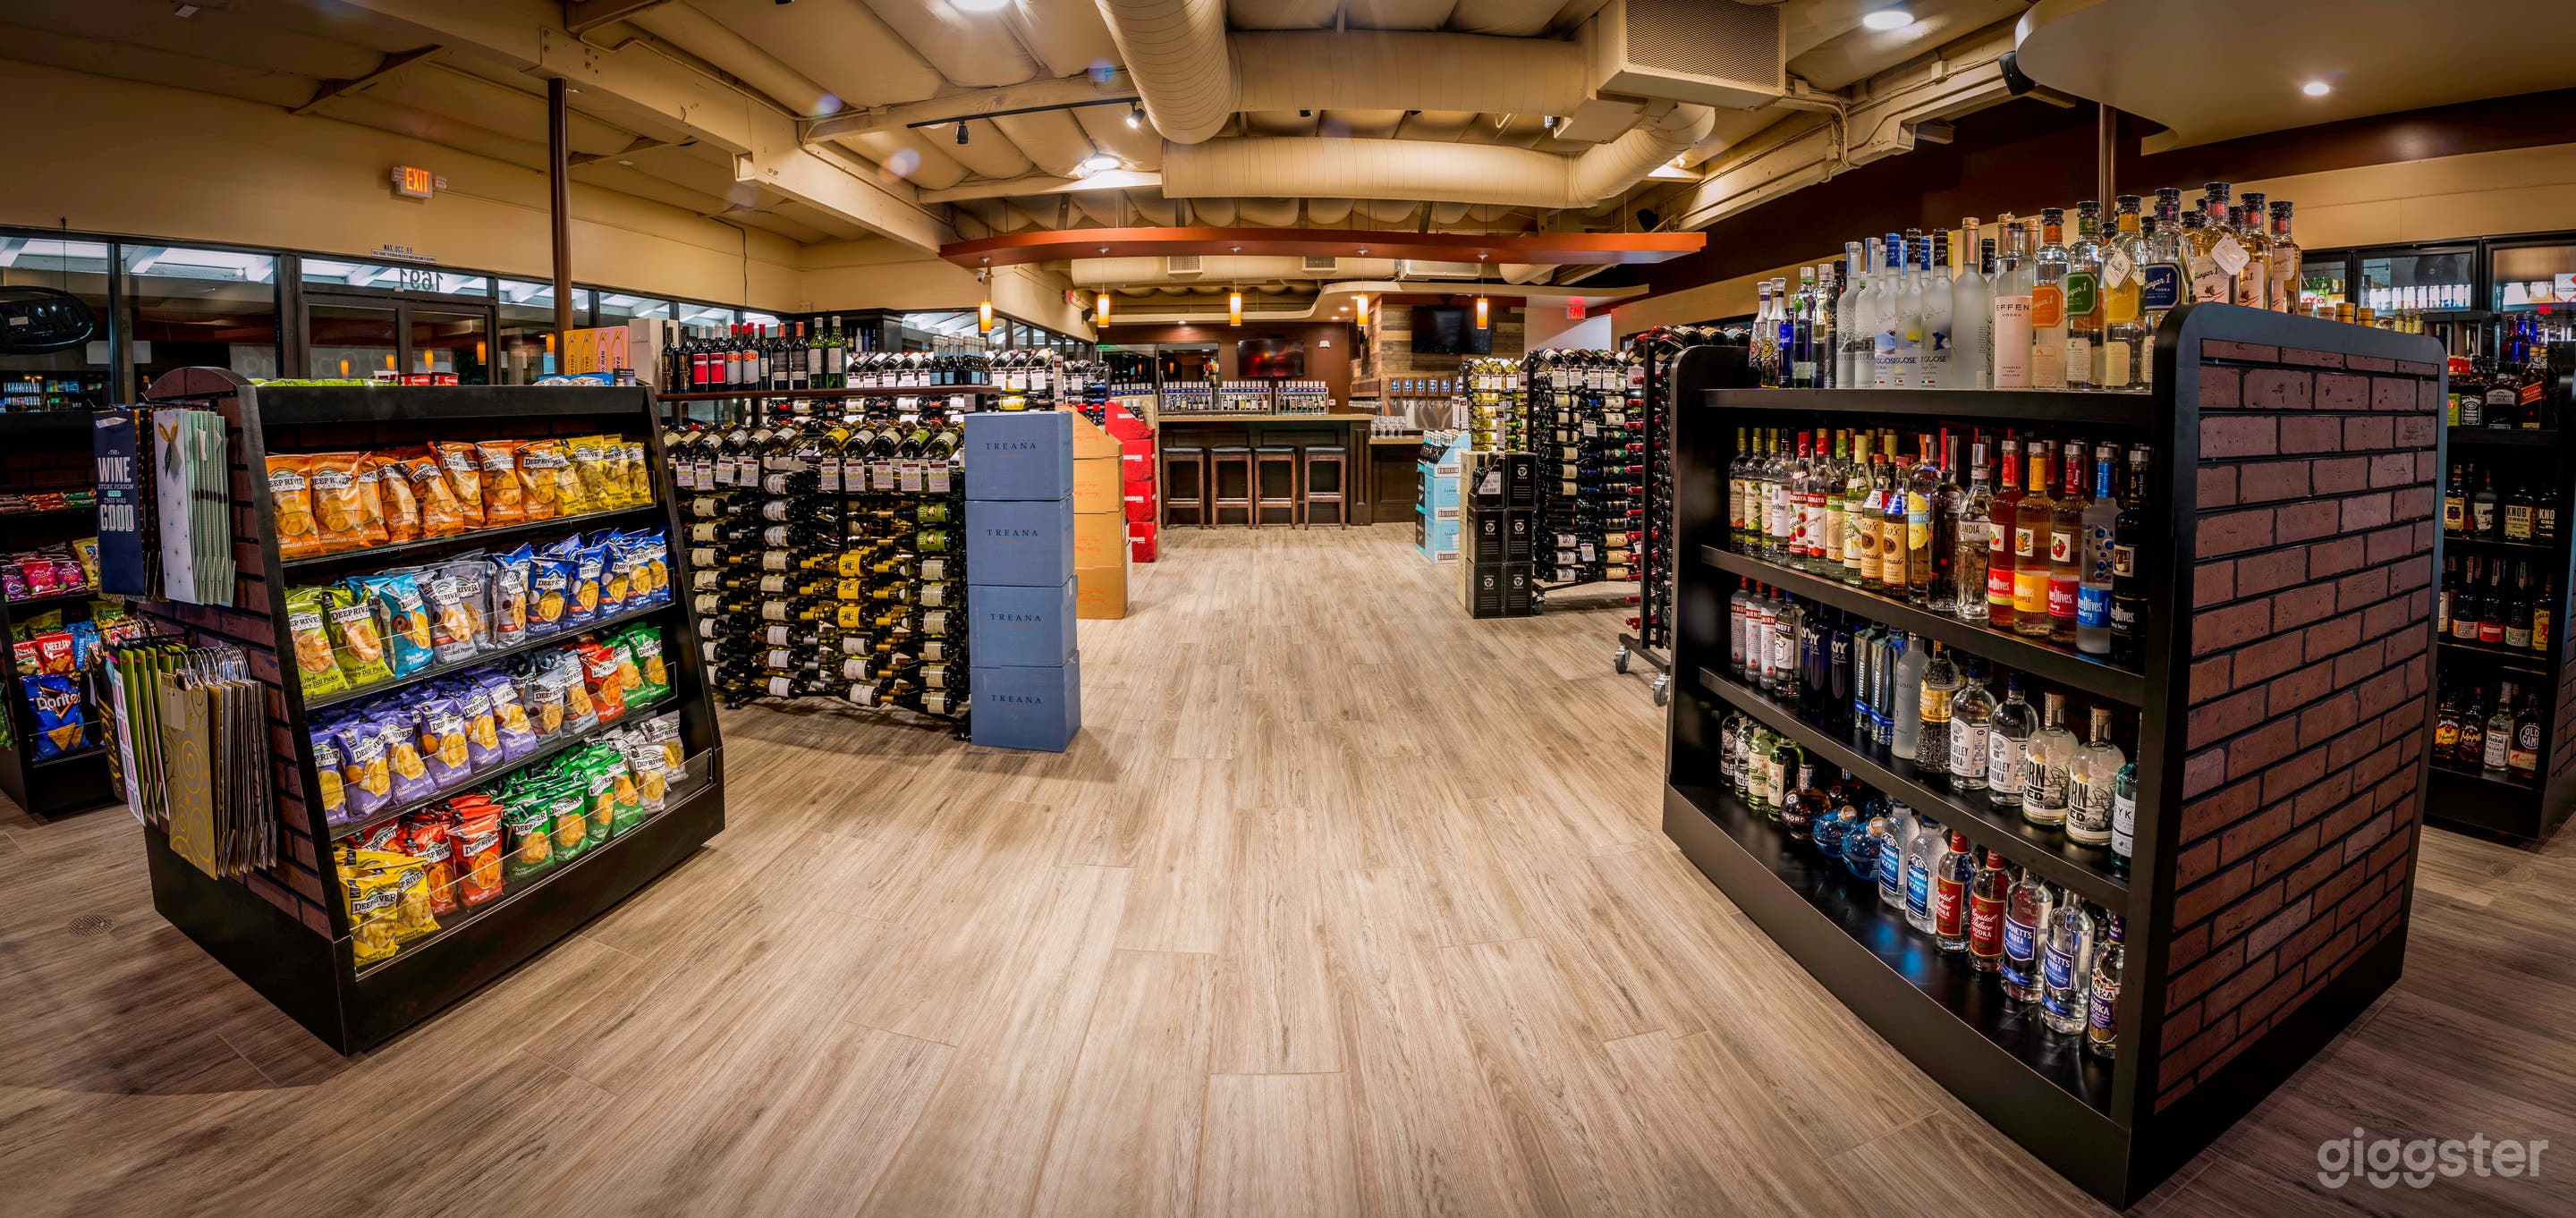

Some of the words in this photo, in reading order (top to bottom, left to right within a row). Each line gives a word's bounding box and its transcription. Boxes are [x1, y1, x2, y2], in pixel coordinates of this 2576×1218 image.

[405, 167, 429, 193] EXIT
[985, 443, 1038, 451] TREANA
[525, 458, 539, 466] DEEP
[540, 458, 553, 466] RIV
[97, 456, 131, 483] WINE
[269, 478, 284, 487] EEP
[284, 478, 304, 487] RIVER
[99, 504, 134, 532] GOOD
[2506, 506, 2527, 518] KNOB
[2539, 509, 2555, 520] KNO
[987, 529, 1038, 537] TREANA
[1961, 521, 1980, 535] ANDIA
[281, 541, 303, 549] seradish
[457, 585, 478, 594] RIVER
[332, 609, 347, 620] DEEP
[990, 613, 1042, 622] TREANA
[35, 691, 81, 711] Doritos
[536, 691, 548, 699] DEEP
[991, 694, 1042, 705] TREANA
[464, 705, 477, 716] DEEP
[394, 729, 412, 739] IVER
[2460, 730, 2482, 742] Maple
[2524, 727, 2540, 735] OLD
[1952, 743, 1970, 757] EATLEY
[1991, 758, 2011, 773] EATLEY
[395, 782, 411, 791] Sweet
[2025, 787, 2044, 801] ED
[2069, 779, 2089, 808] RN
[2069, 808, 2086, 823] ED
[2114, 803, 2131, 820] EYK
[380, 828, 397, 842] RIV
[465, 842, 480, 854] DEEP
[376, 893, 396, 905] IVER
[1972, 908, 1998, 923] Crystal
[1972, 917, 1993, 931] Palace
[2094, 986, 2114, 1000] AKA
